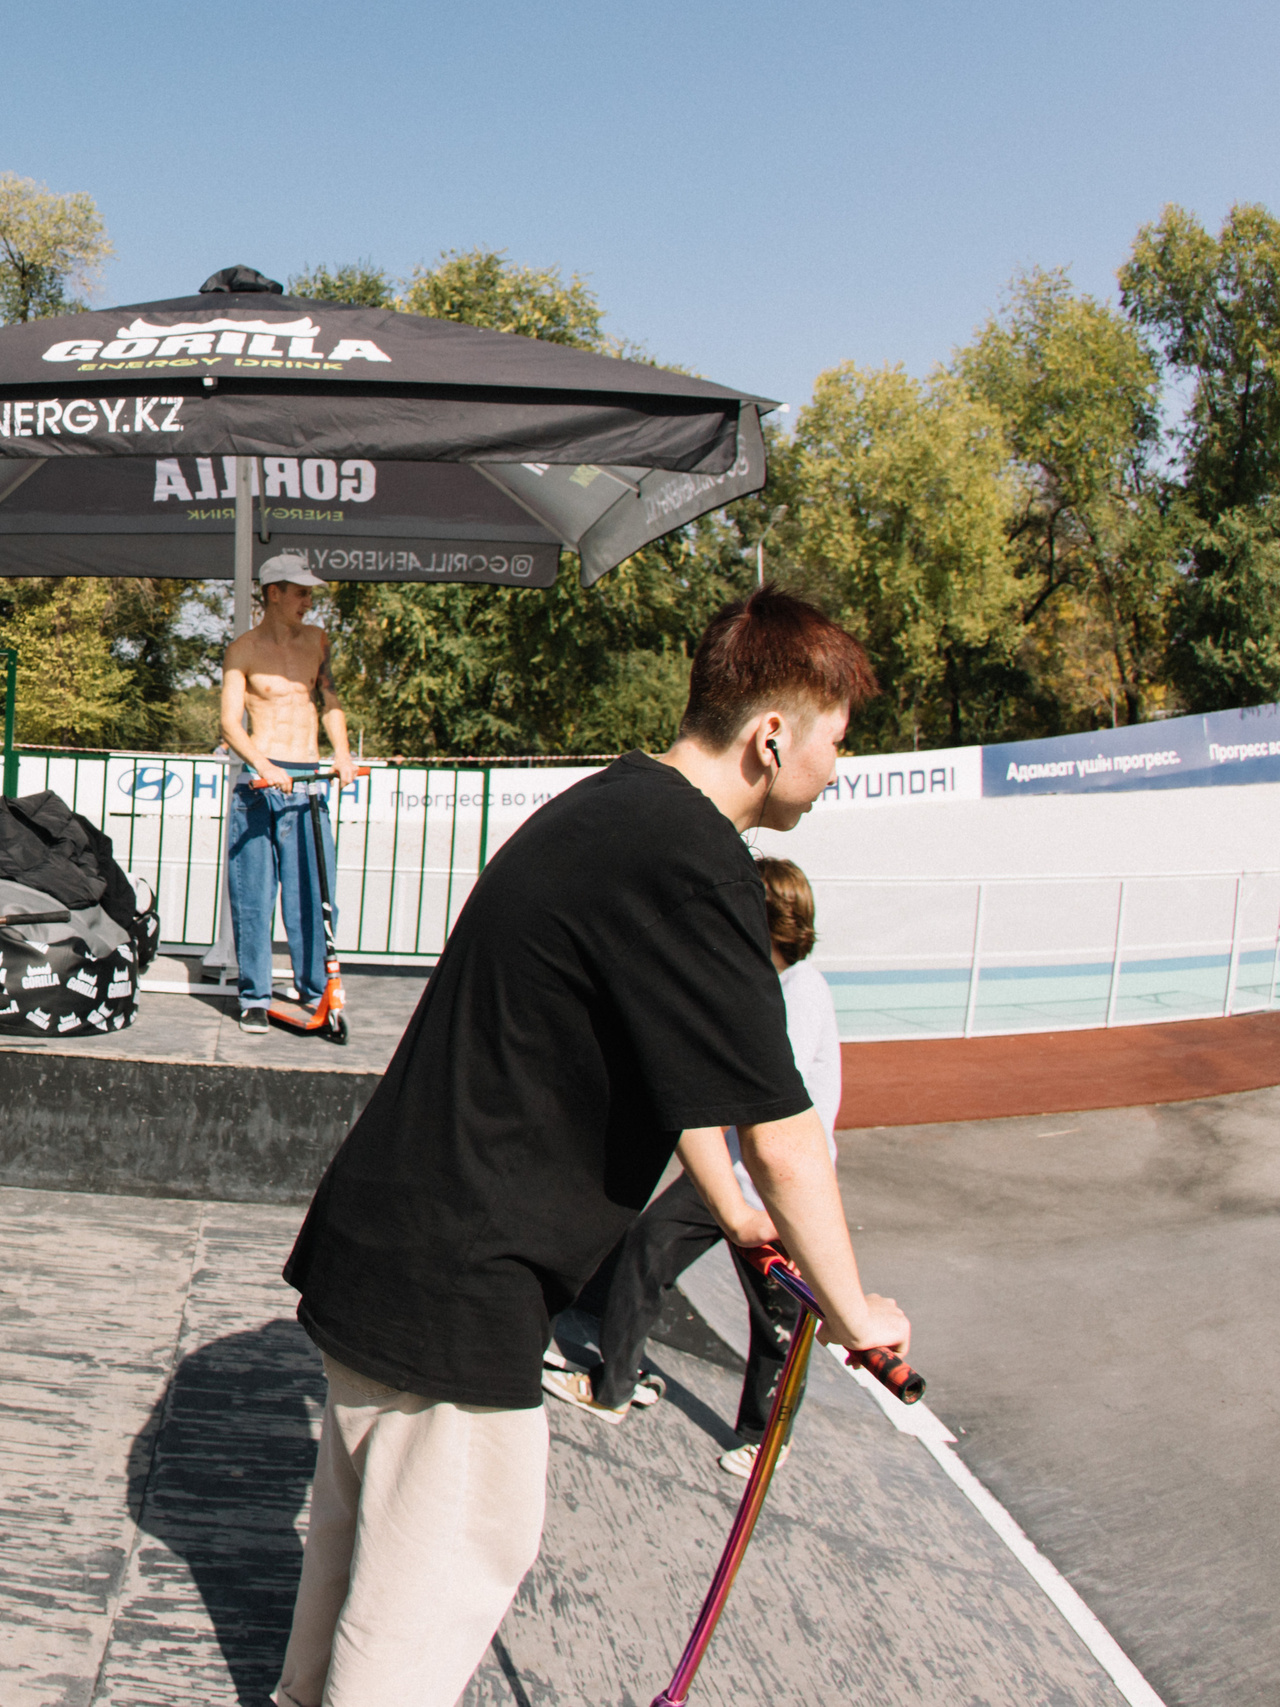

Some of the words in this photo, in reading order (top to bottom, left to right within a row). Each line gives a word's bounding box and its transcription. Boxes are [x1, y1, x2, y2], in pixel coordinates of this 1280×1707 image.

[42, 331, 392, 362] GORILLA
[77, 357, 222, 371] ENERGY
[234, 358, 344, 370] DRINK
[1208, 742, 1269, 763] Прогресс
[1006, 762, 1076, 782] Адамзат
[822, 767, 954, 801] HYUNDAI
[390, 791, 494, 812] Прогресс
[502, 792, 526, 806] во
[21, 972, 60, 989] GORILLA
